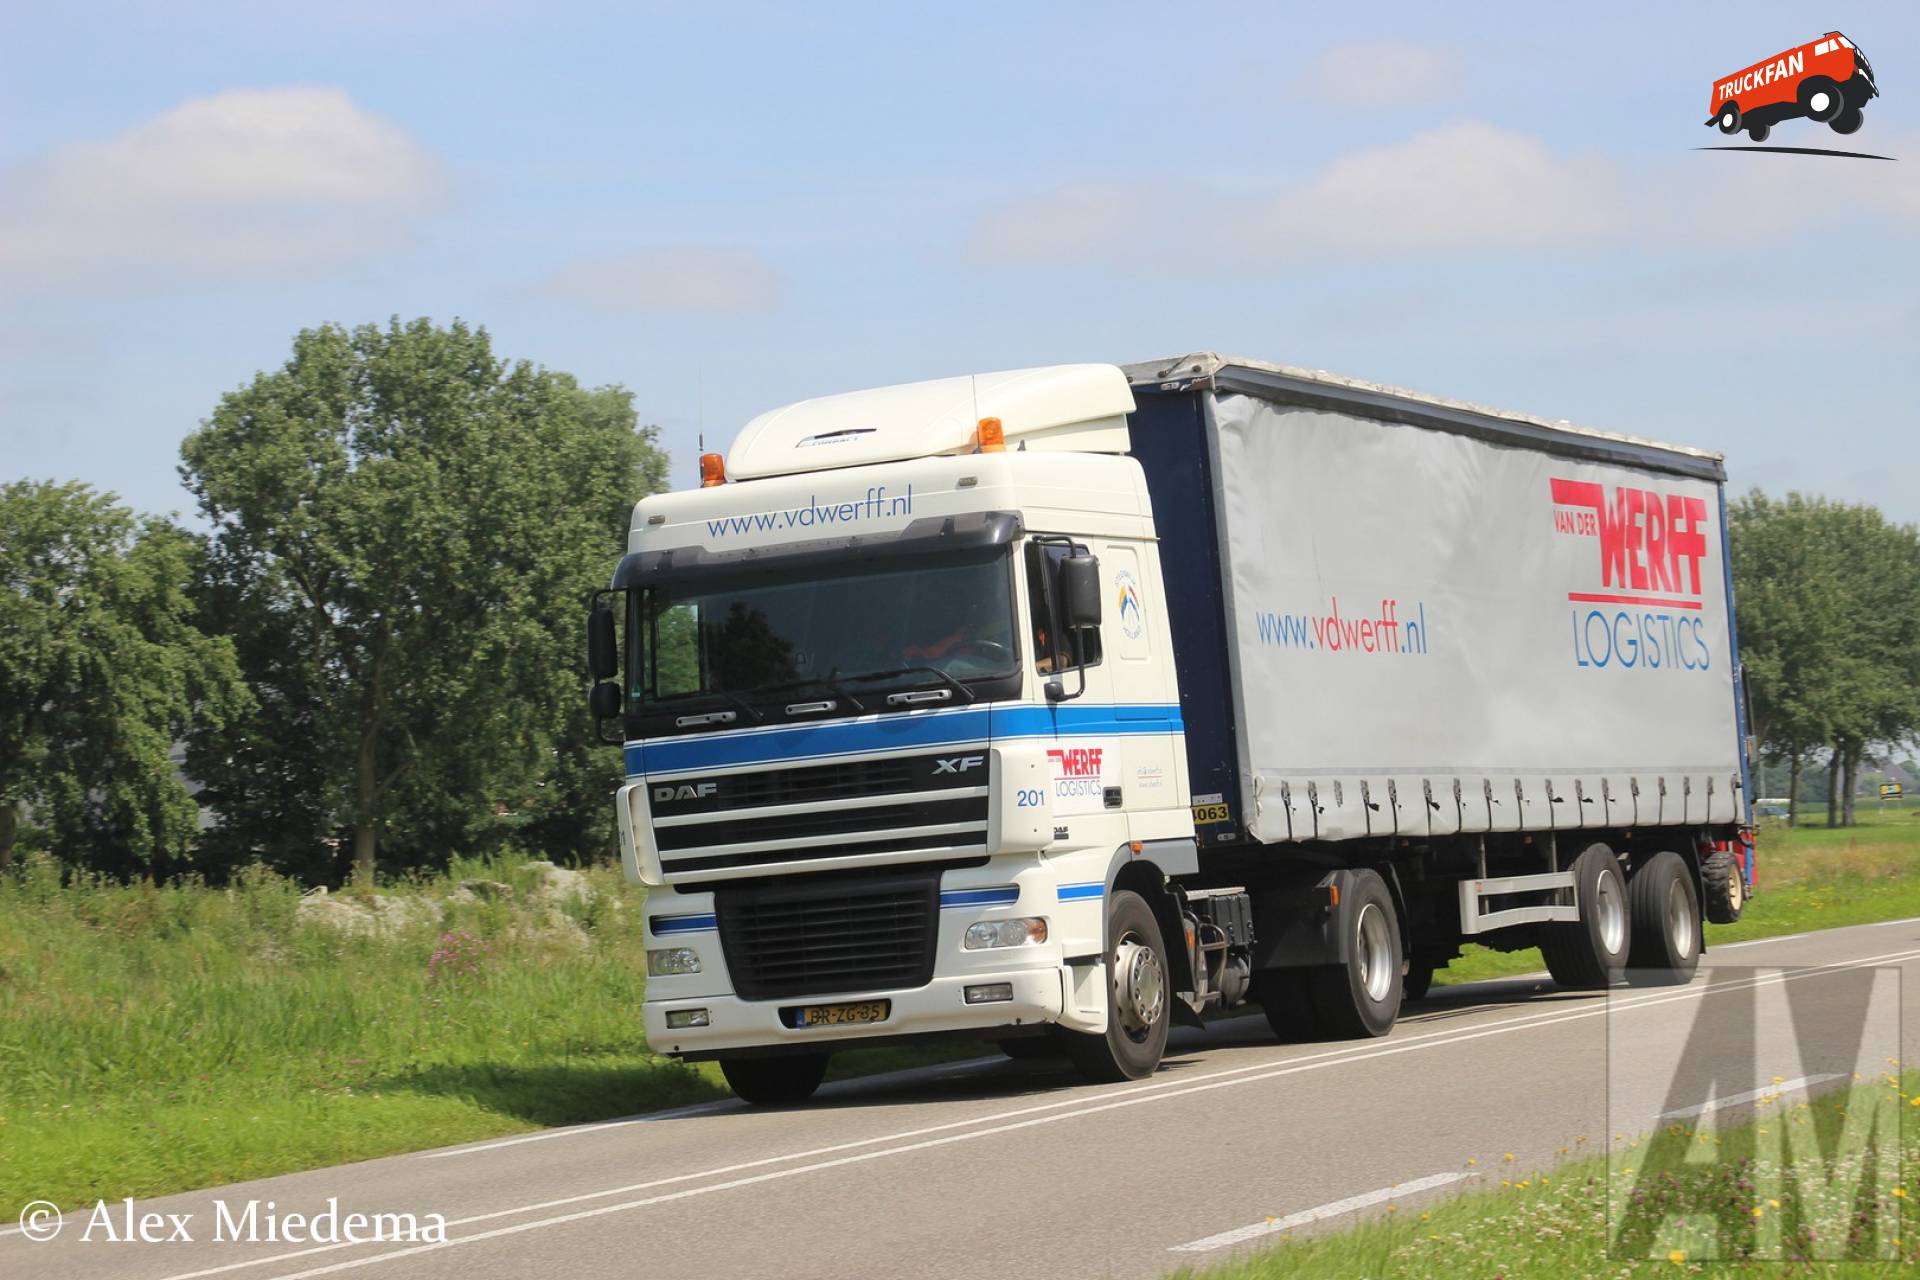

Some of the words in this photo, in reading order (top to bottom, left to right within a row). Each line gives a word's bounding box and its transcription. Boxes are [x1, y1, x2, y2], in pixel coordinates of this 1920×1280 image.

[707, 483, 912, 538] www.vdwerff.nl
[1553, 510, 1575, 534] VAN
[1577, 512, 1598, 536] DER
[1596, 482, 1707, 595] WERFF
[1255, 596, 1427, 654] www.vdwerff.nl
[1572, 610, 1710, 671] LOGISTICS
[931, 755, 984, 775] XF
[1059, 748, 1102, 776] WERFF
[653, 782, 717, 802] DAF
[1016, 789, 1045, 807] 201
[1055, 779, 1102, 797] LOGISTICS
